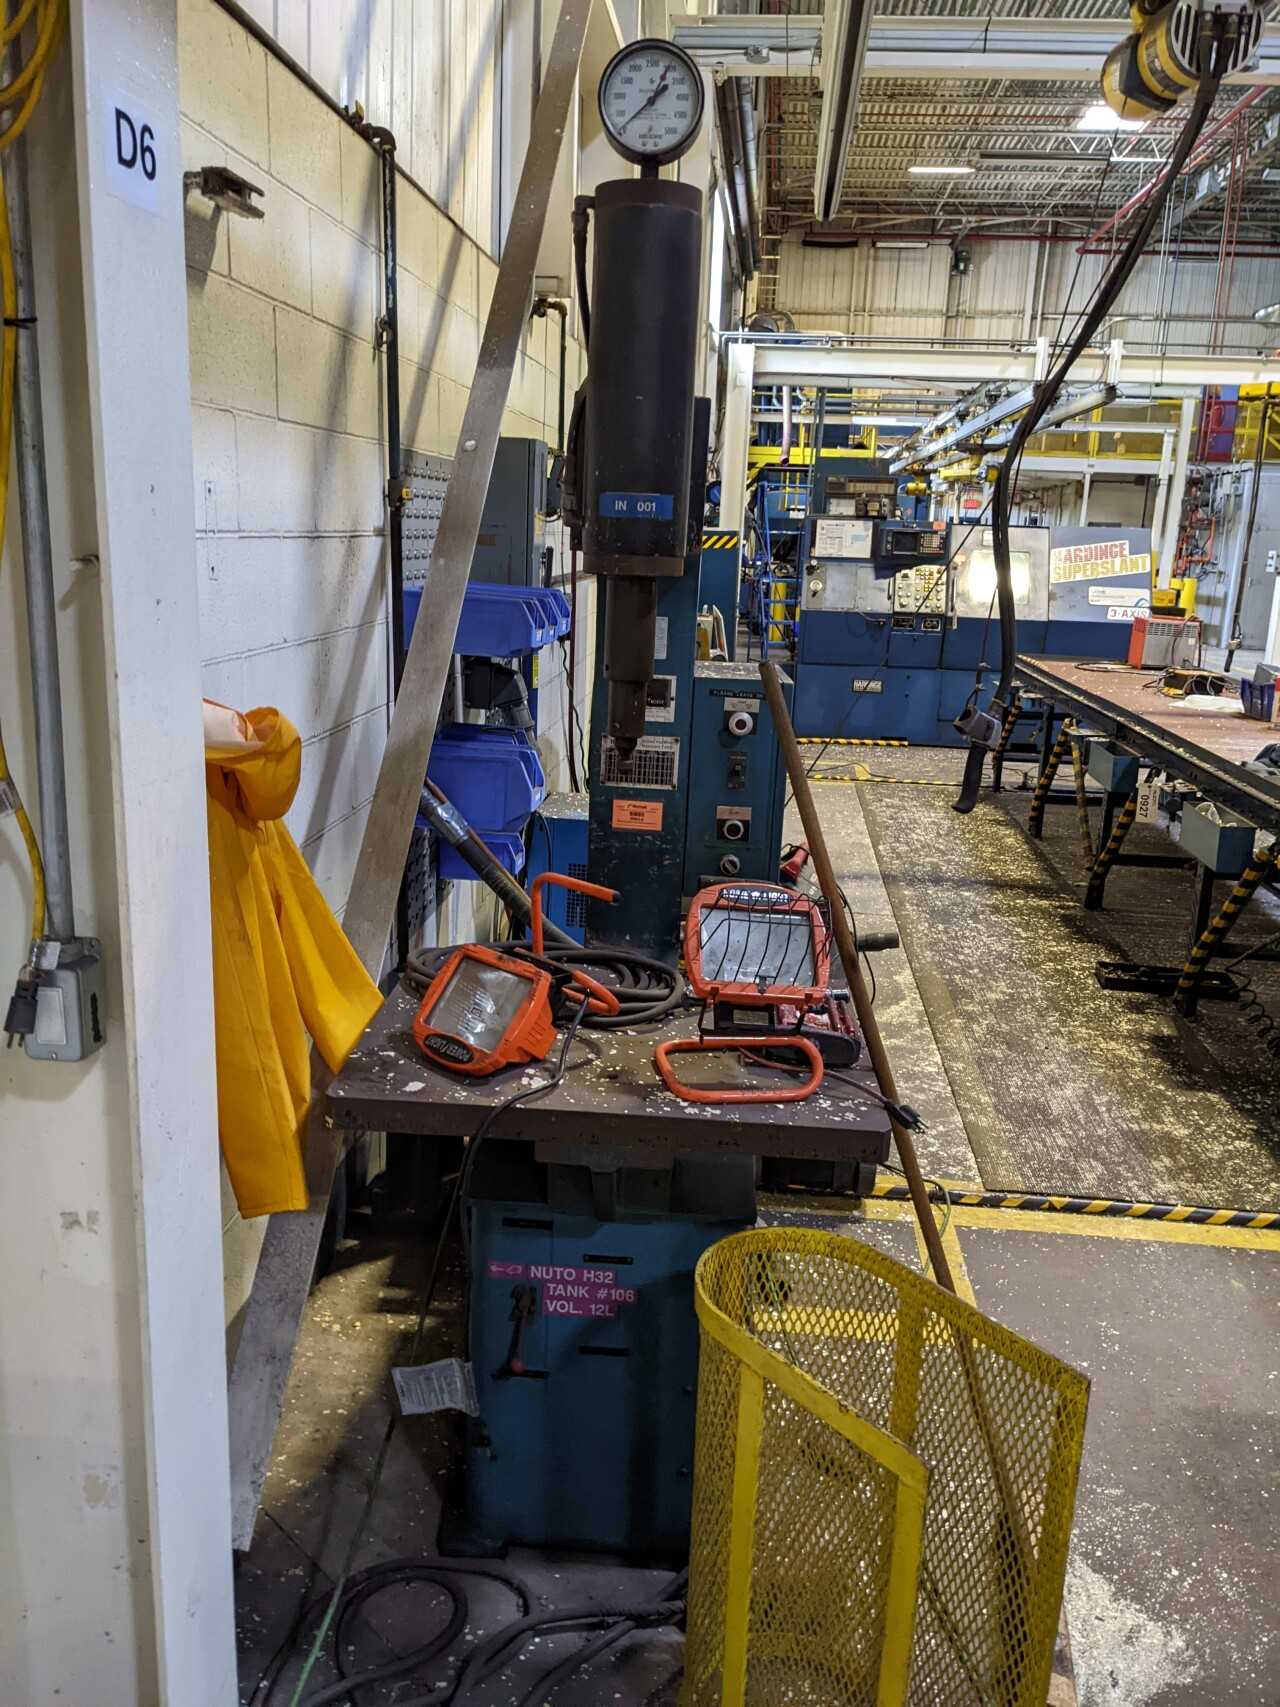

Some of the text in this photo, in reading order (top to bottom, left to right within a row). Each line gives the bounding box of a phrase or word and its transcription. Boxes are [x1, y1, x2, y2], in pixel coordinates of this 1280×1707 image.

[115, 106, 156, 181] D6
[615, 500, 656, 512] IN 001
[1053, 555, 1149, 582] SUPERSLANT
[1139, 794, 1150, 818] 0927
[530, 1265, 614, 1284] NUTO H32
[547, 1283, 589, 1298] TANK
[546, 1300, 615, 1317] VOL. 12L
